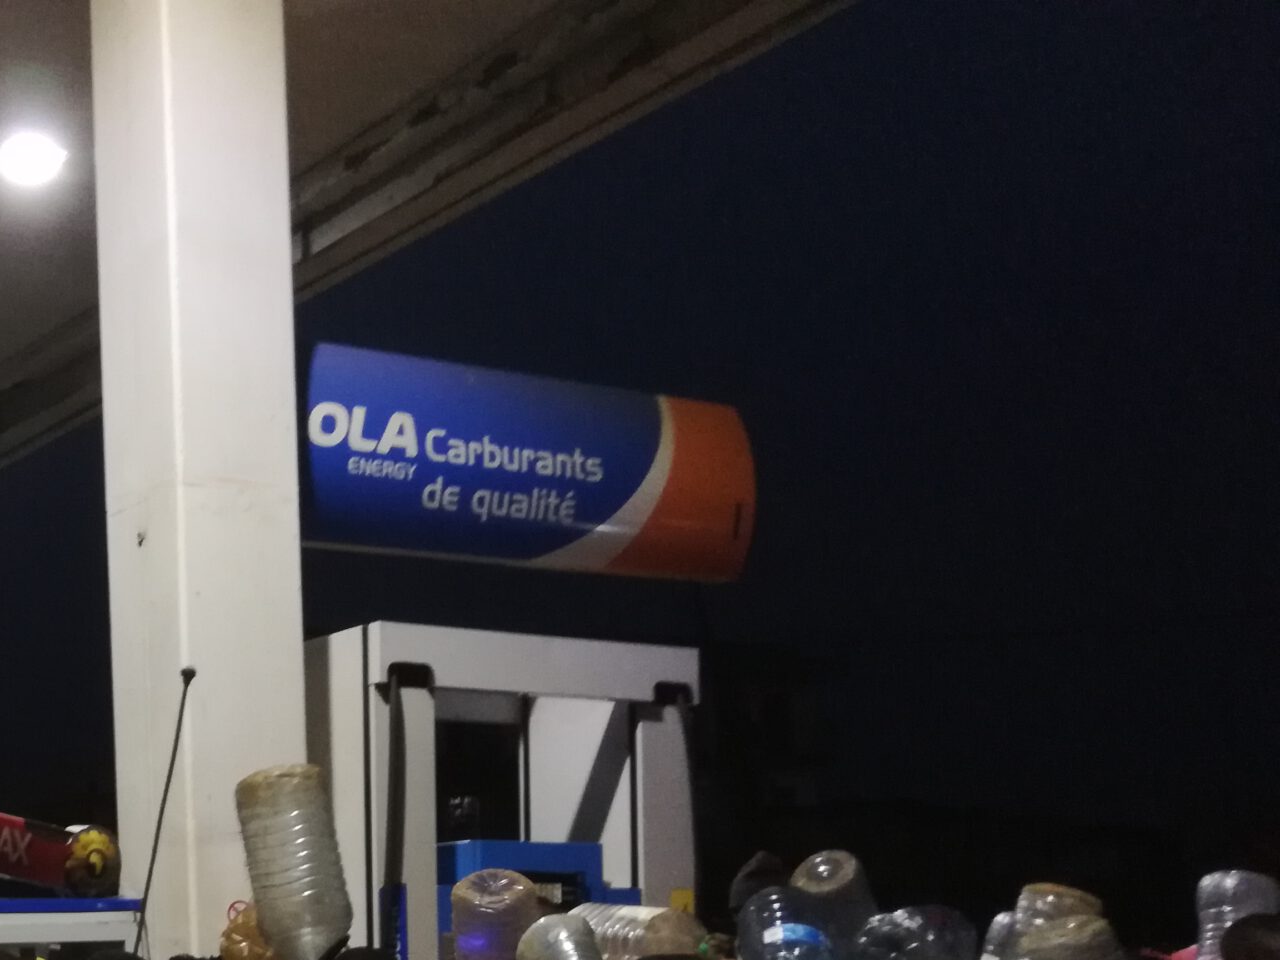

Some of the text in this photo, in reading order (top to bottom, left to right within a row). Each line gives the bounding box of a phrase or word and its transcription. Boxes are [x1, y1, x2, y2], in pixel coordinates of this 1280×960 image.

[307, 401, 419, 458] OLA
[424, 428, 604, 483] Carburants
[348, 456, 417, 481] ENERGY
[421, 476, 577, 526] de qualité
